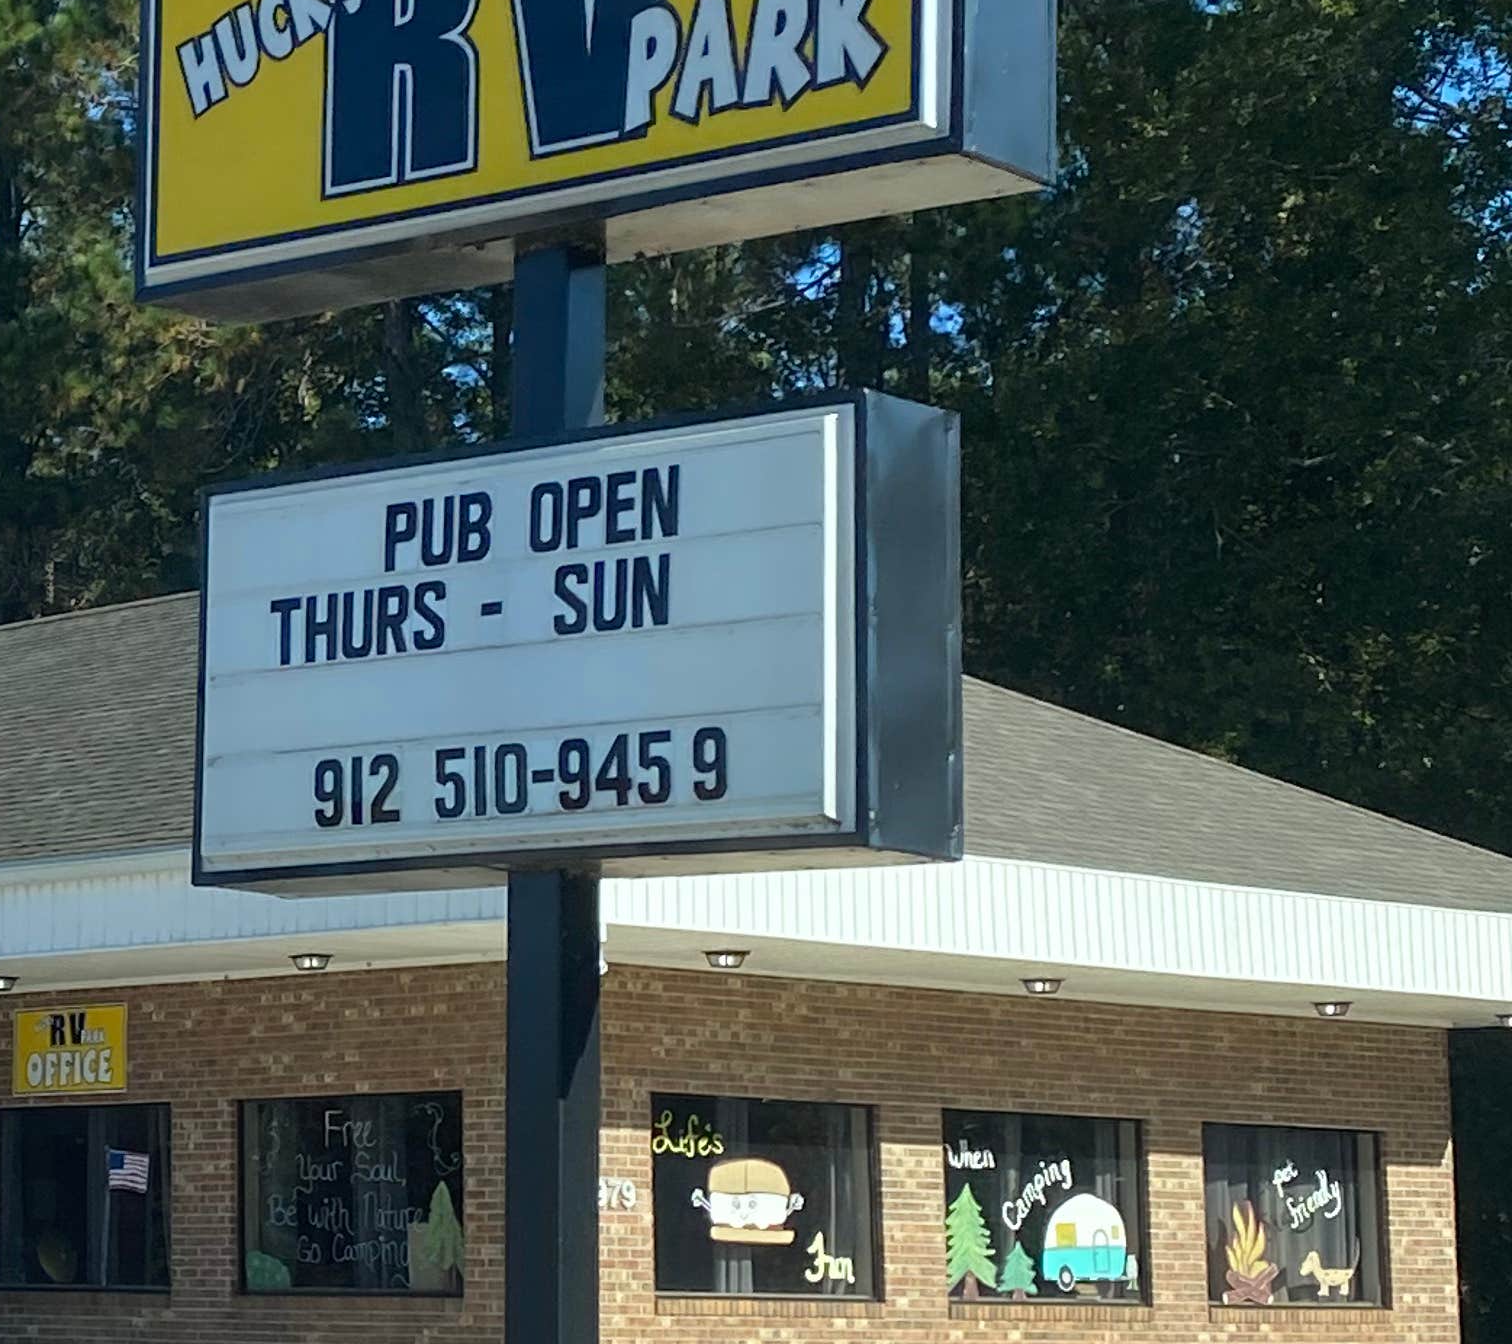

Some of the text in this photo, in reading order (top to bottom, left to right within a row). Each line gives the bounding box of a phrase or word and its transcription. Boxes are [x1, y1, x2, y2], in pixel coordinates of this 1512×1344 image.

[384, 464, 680, 572] PUB OPEN
[270, 580, 446, 666] THURS
[553, 554, 670, 635] SUN
[314, 754, 400, 828] 912
[50, 1013, 85, 1046] RV
[27, 1048, 112, 1087] OFFICE
[324, 1110, 377, 1148] Free
[651, 1109, 725, 1158] Life's
[944, 1138, 996, 1169] When
[292, 1152, 344, 1201] Your
[1002, 1159, 1073, 1231] Camping
[308, 1196, 355, 1236] with
[296, 1235, 322, 1264] Go
